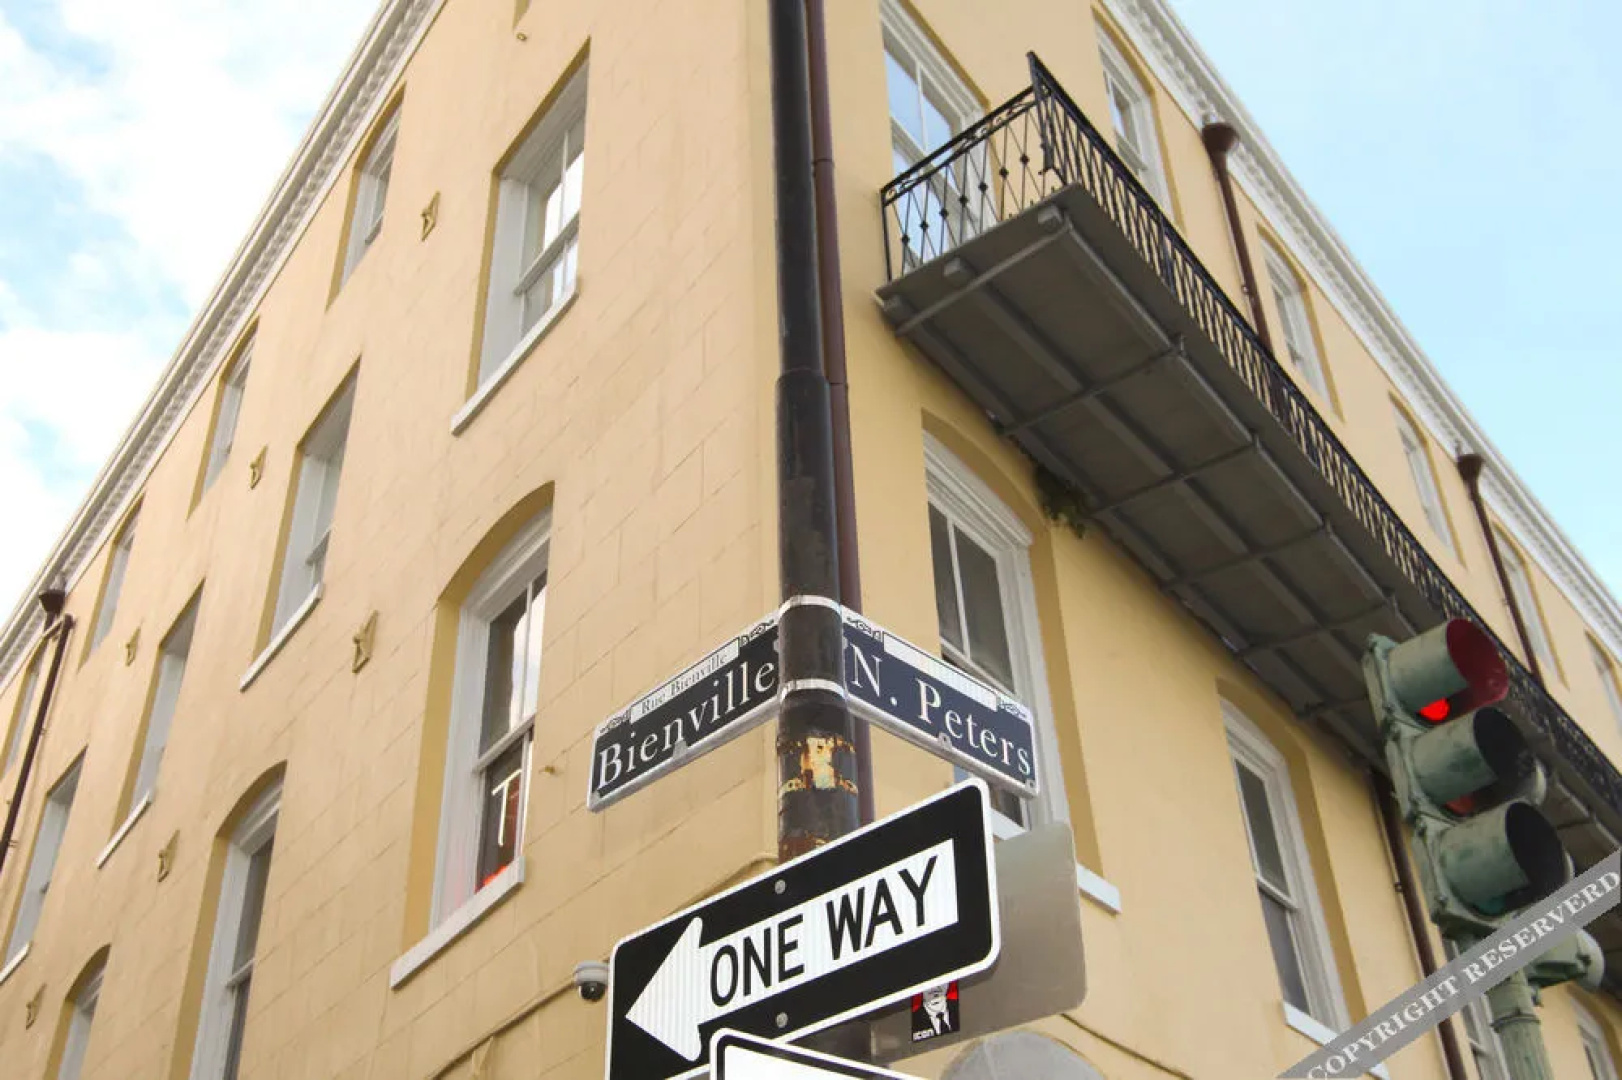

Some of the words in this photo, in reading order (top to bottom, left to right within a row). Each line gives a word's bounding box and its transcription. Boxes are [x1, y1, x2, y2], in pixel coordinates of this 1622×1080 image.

[597, 661, 775, 790] Bienville
[641, 693, 666, 714] Rue
[671, 654, 728, 695] Bienville
[849, 643, 898, 707] N.
[916, 677, 1031, 775] Peters
[710, 914, 804, 1007] ONE
[826, 855, 939, 961] WAY
